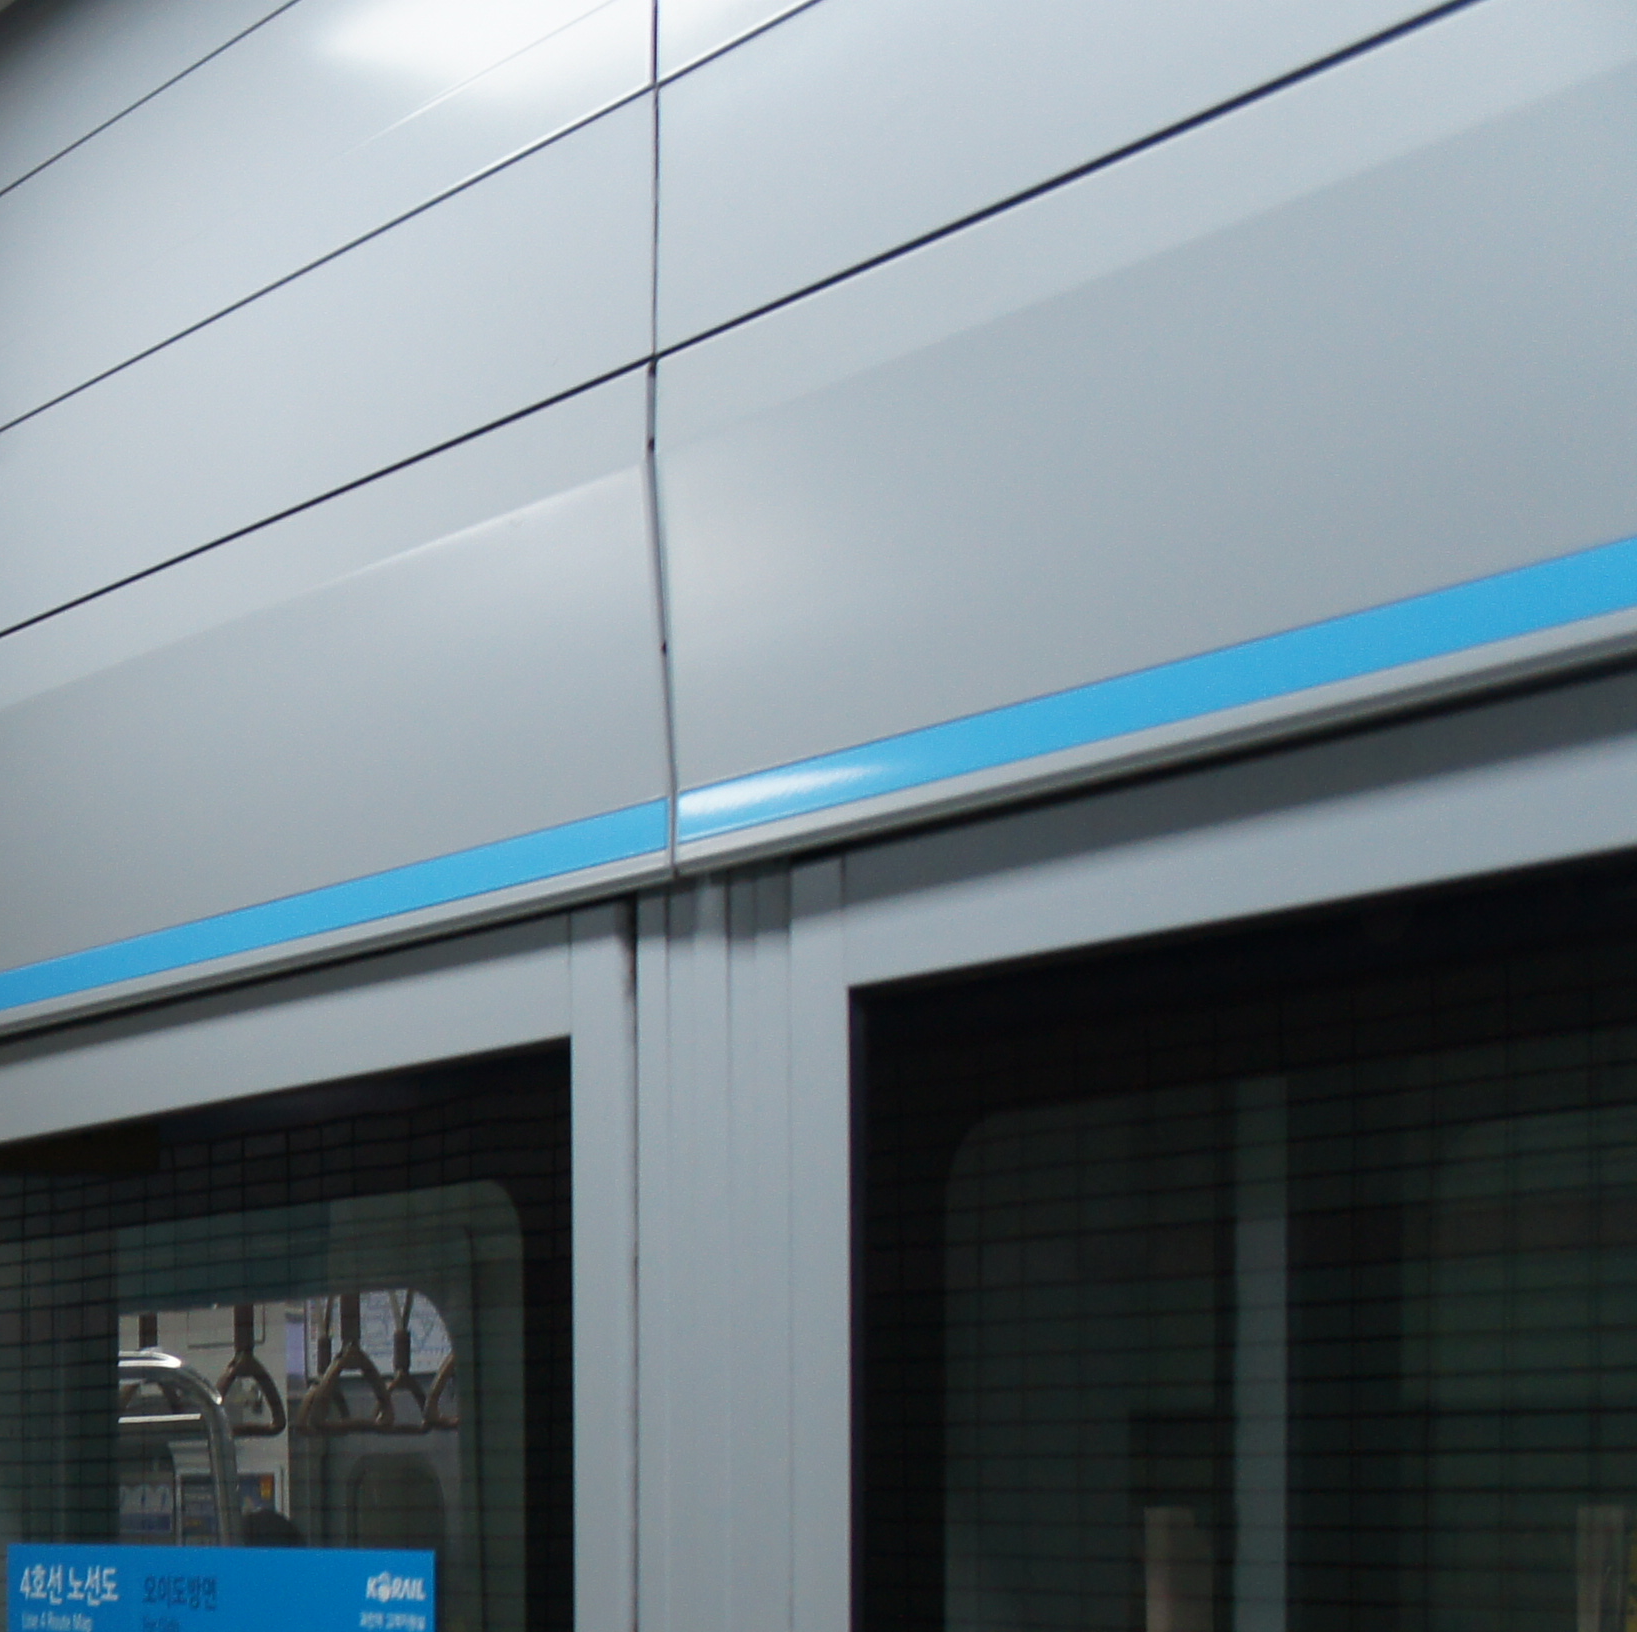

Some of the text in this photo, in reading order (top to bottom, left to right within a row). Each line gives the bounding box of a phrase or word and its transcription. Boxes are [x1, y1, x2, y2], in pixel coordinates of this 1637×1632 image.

[20, 1563, 119, 1607] 4호선 노선도
[366, 1571, 426, 1603] KORAIL
